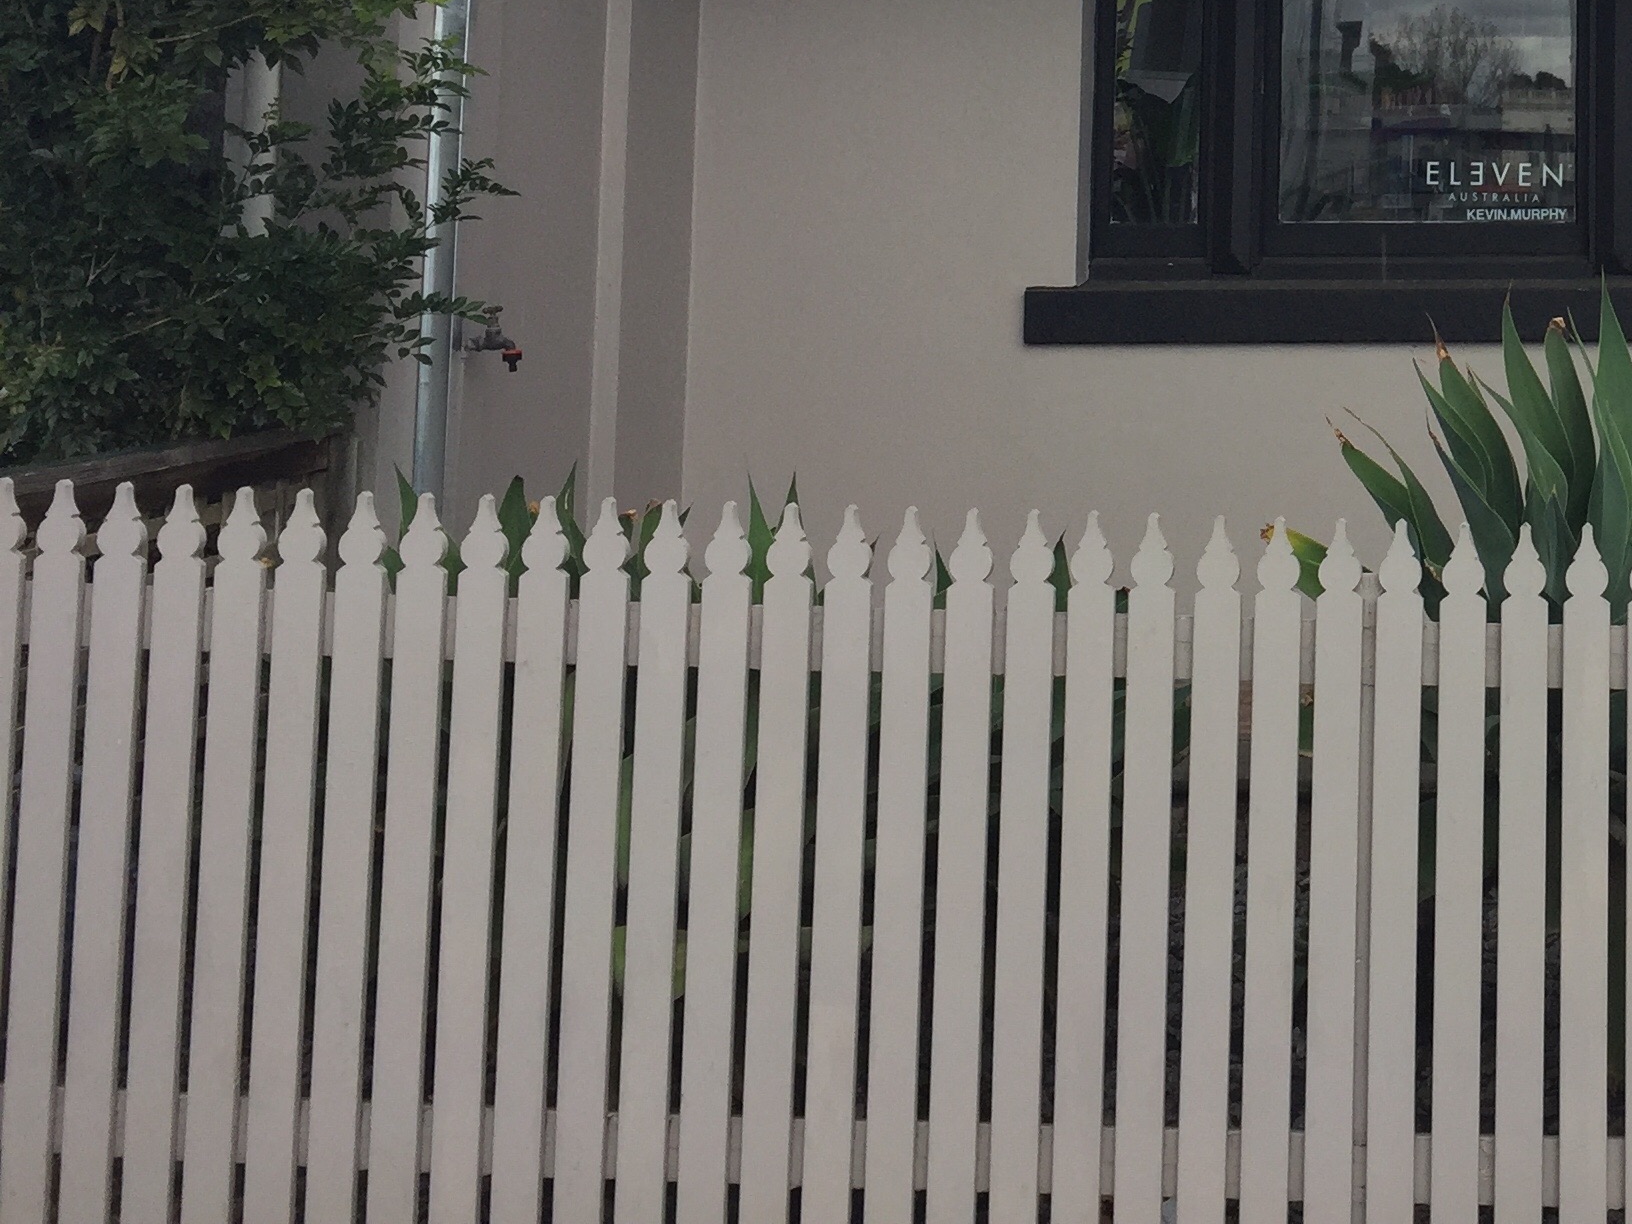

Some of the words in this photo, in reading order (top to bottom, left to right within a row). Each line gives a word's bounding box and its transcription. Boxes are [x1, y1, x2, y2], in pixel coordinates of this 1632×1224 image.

[1426, 160, 1564, 187] ELEVEN
[1447, 191, 1541, 204] AUSTRALIA
[1465, 208, 1568, 222] KEVIN.MURPHY
